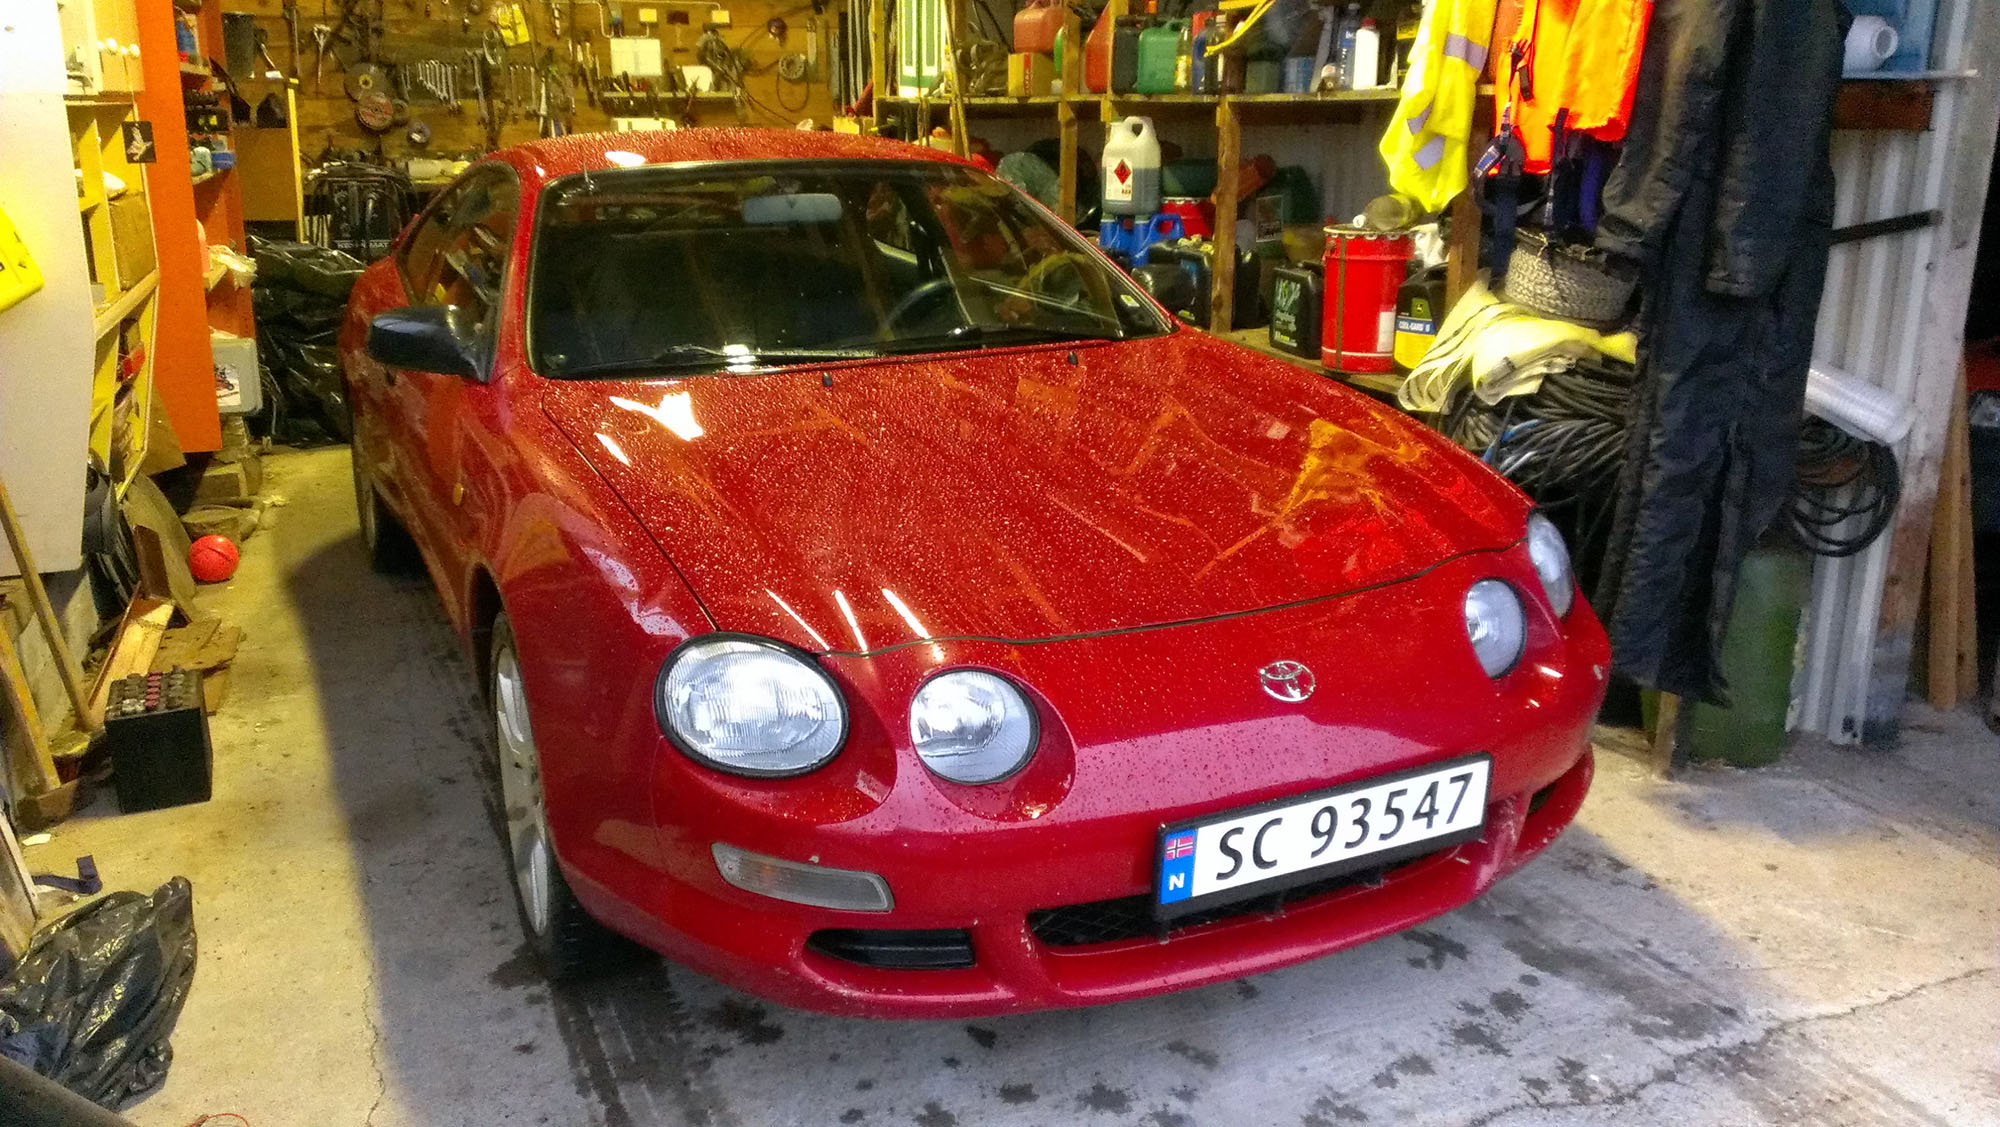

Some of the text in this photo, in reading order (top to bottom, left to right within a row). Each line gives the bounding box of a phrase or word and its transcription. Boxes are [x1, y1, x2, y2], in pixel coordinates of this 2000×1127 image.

[1215, 771, 1474, 881] SC 93547
[1168, 872, 1186, 891] N
